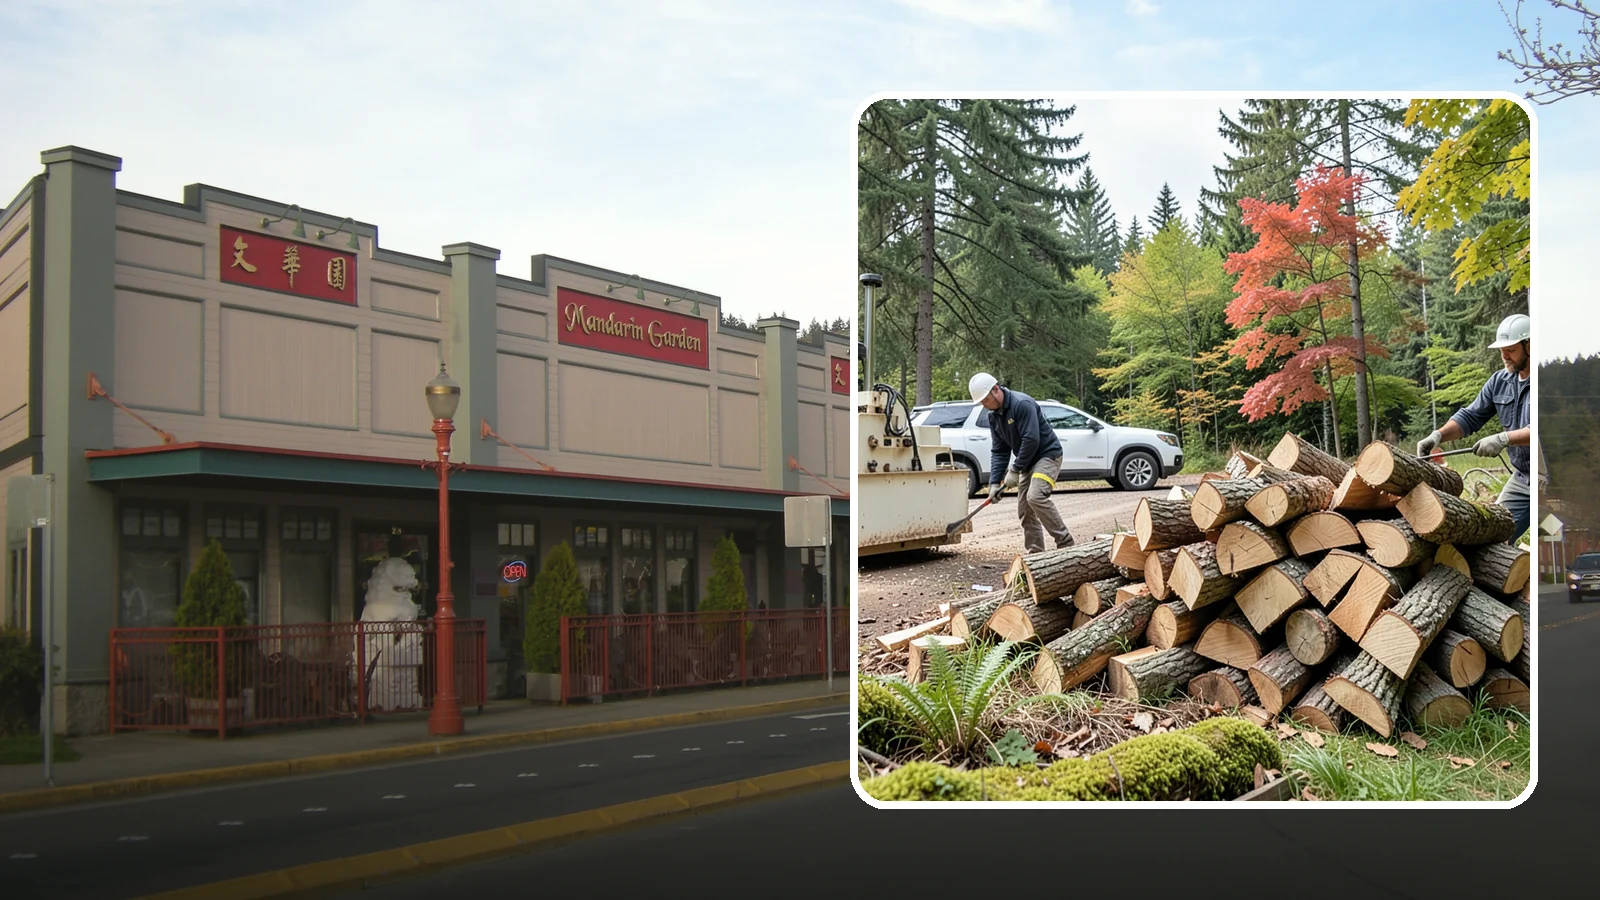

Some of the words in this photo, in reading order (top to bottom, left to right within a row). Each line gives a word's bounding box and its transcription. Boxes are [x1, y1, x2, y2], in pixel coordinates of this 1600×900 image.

[231, 236, 346, 290] 文華園
[564, 302, 644, 341] Mandarin
[647, 320, 701, 352] Garden
[835, 363, 846, 386] 文
[503, 565, 527, 578] OPEN
